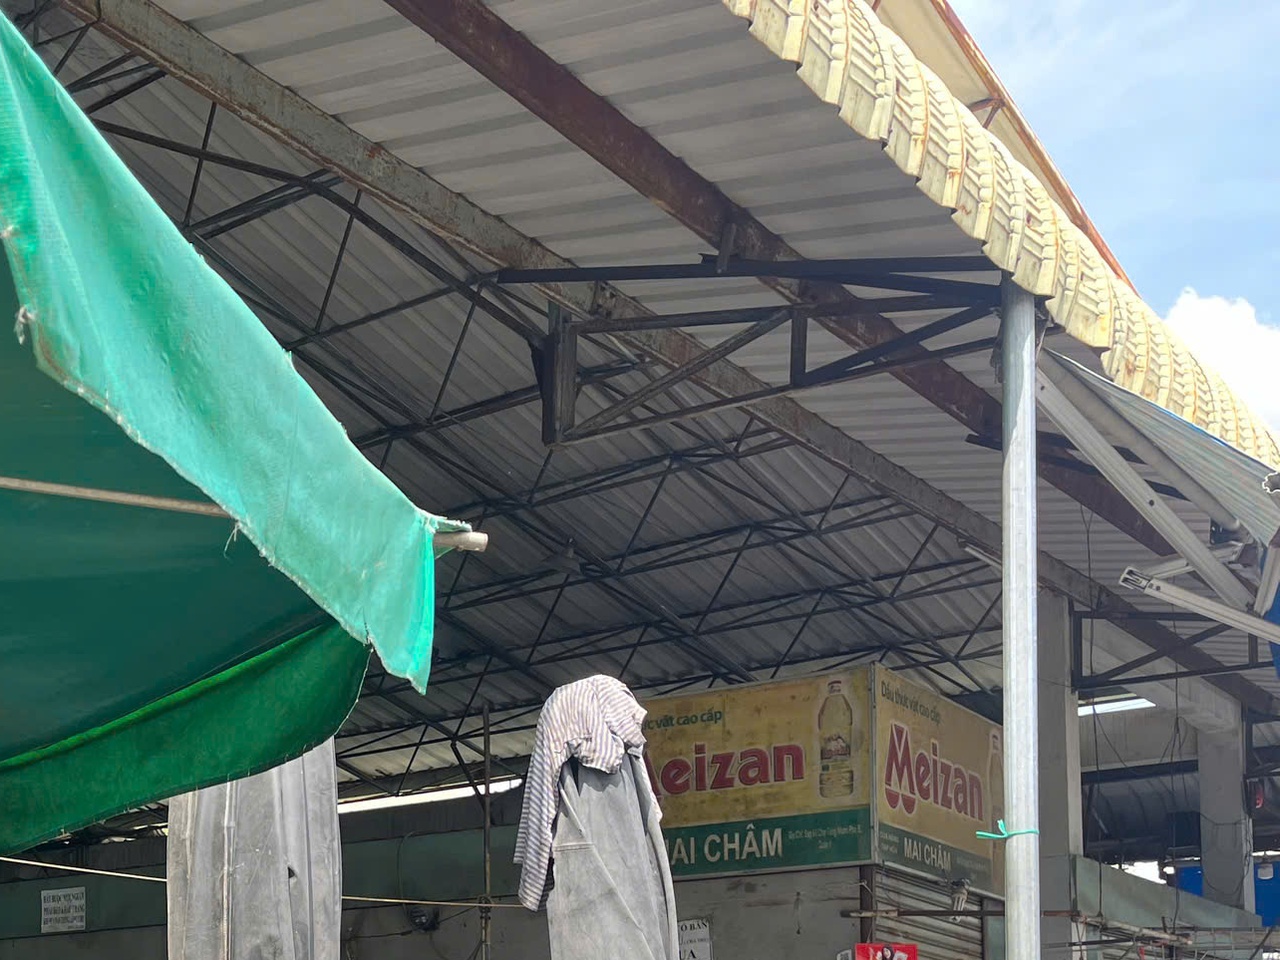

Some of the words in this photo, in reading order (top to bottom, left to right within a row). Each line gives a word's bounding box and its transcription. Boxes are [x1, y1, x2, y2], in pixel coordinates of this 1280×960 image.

[676, 714, 699, 726] cao
[885, 723, 983, 821] Meizan
[666, 837, 695, 866] AI
[704, 823, 783, 862] CHÂM
[904, 837, 922, 862] MAI
[924, 844, 951, 871] CHÂM
